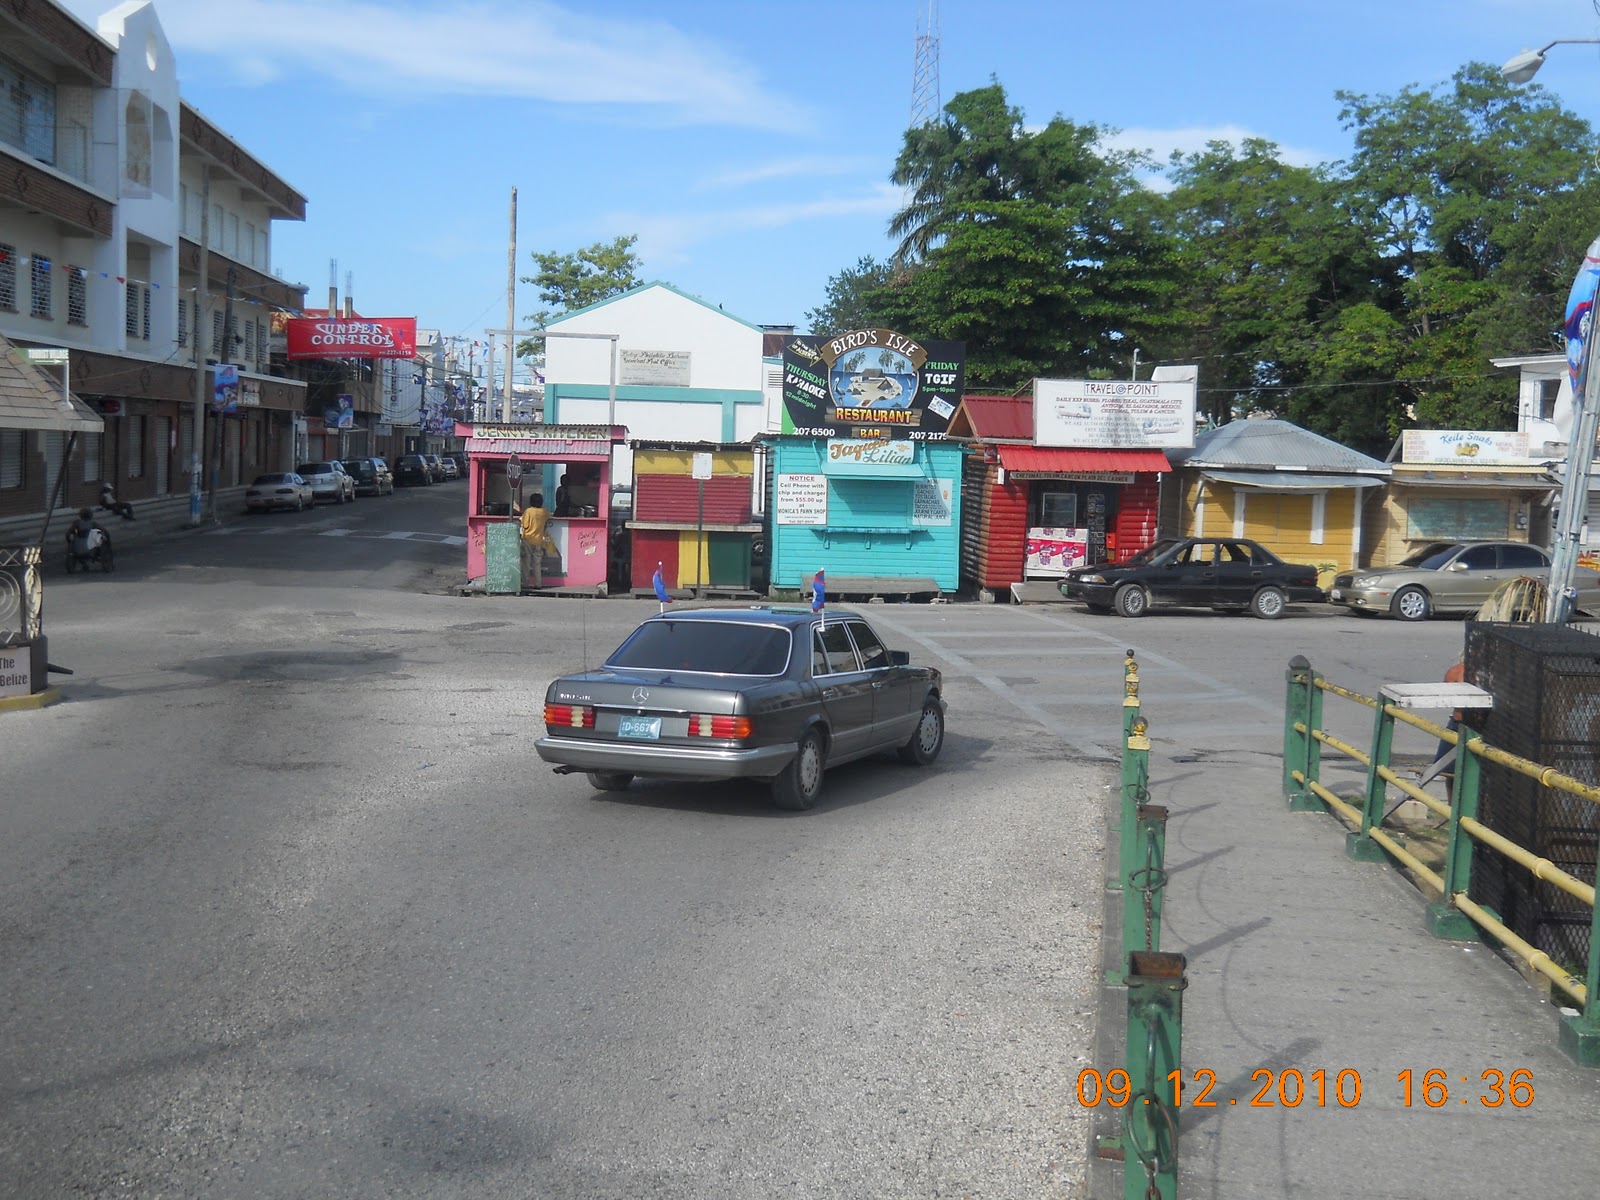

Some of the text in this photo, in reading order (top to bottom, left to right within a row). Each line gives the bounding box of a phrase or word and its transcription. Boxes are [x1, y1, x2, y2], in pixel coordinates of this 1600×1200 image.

[324, 322, 383, 334] UNDER
[311, 334, 394, 345] CONTROL
[830, 330, 919, 357] BIRD'S ISLE
[924, 361, 960, 371] FRIDAY
[786, 362, 828, 387] THURSDAY
[924, 373, 957, 385] TGIF
[785, 373, 827, 399] KARAOKE
[835, 407, 912, 424] RESTAURANT
[477, 424, 607, 439] JENNY'S KITCHEN
[860, 428, 880, 439] BAR
[508, 463, 521, 479] STOP
[0, 674, 28, 687] Belize
